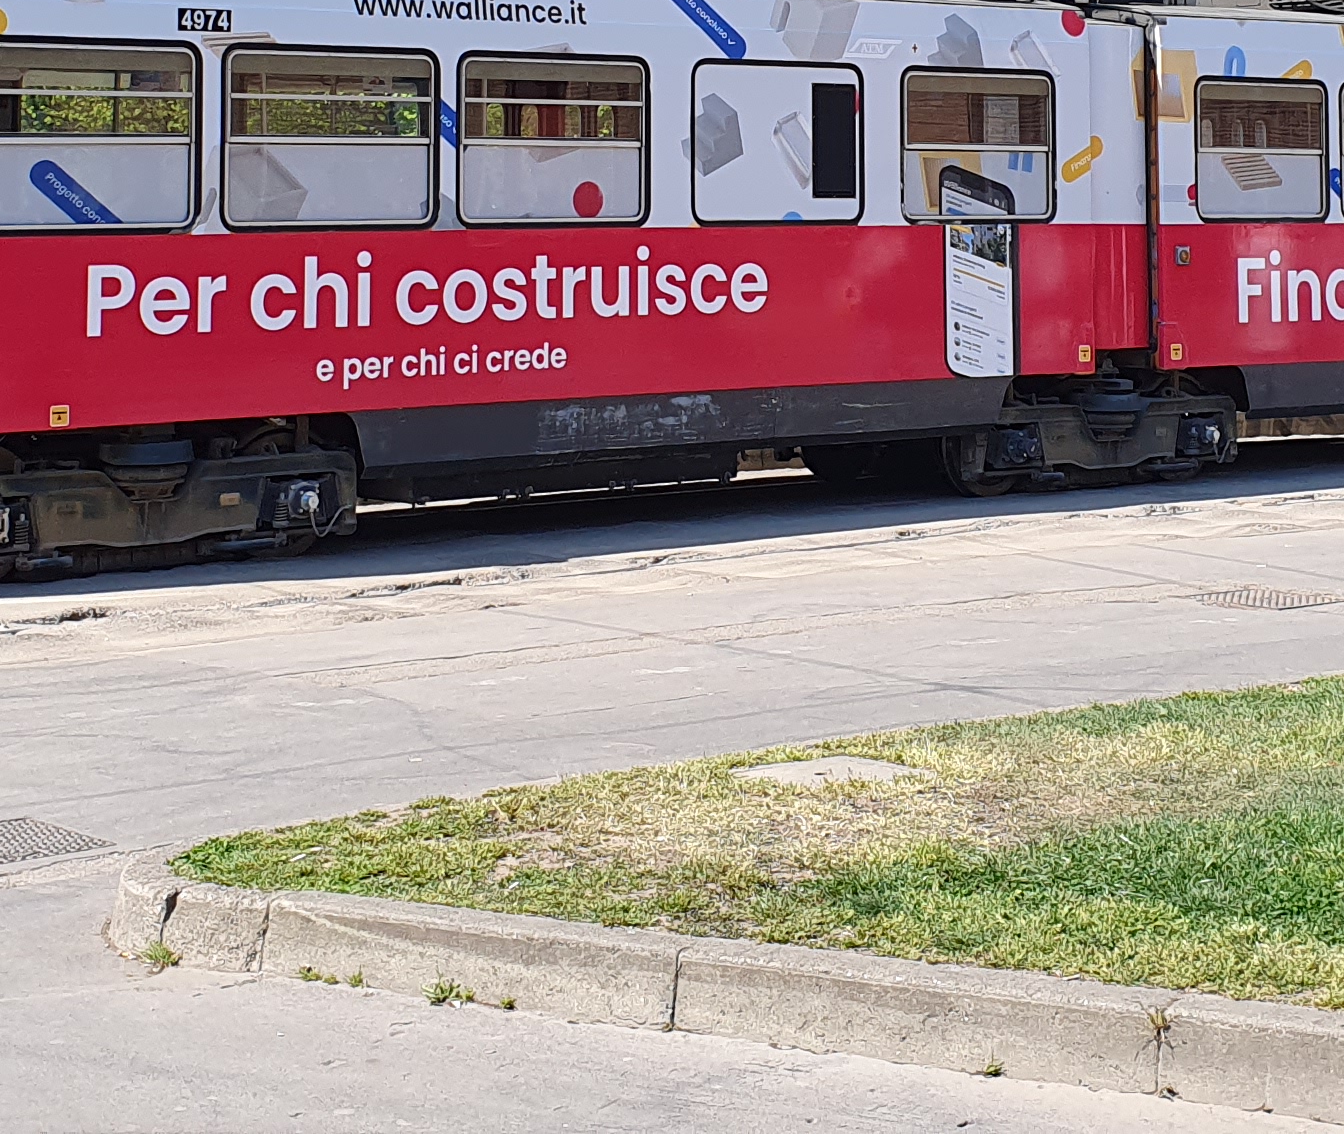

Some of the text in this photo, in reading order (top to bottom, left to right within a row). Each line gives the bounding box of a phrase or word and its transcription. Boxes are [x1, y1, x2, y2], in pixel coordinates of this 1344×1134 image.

[182, 10, 229, 30] 4974
[87, 246, 768, 337] Per chi costruisce
[317, 342, 567, 389] e per chi ci crede
